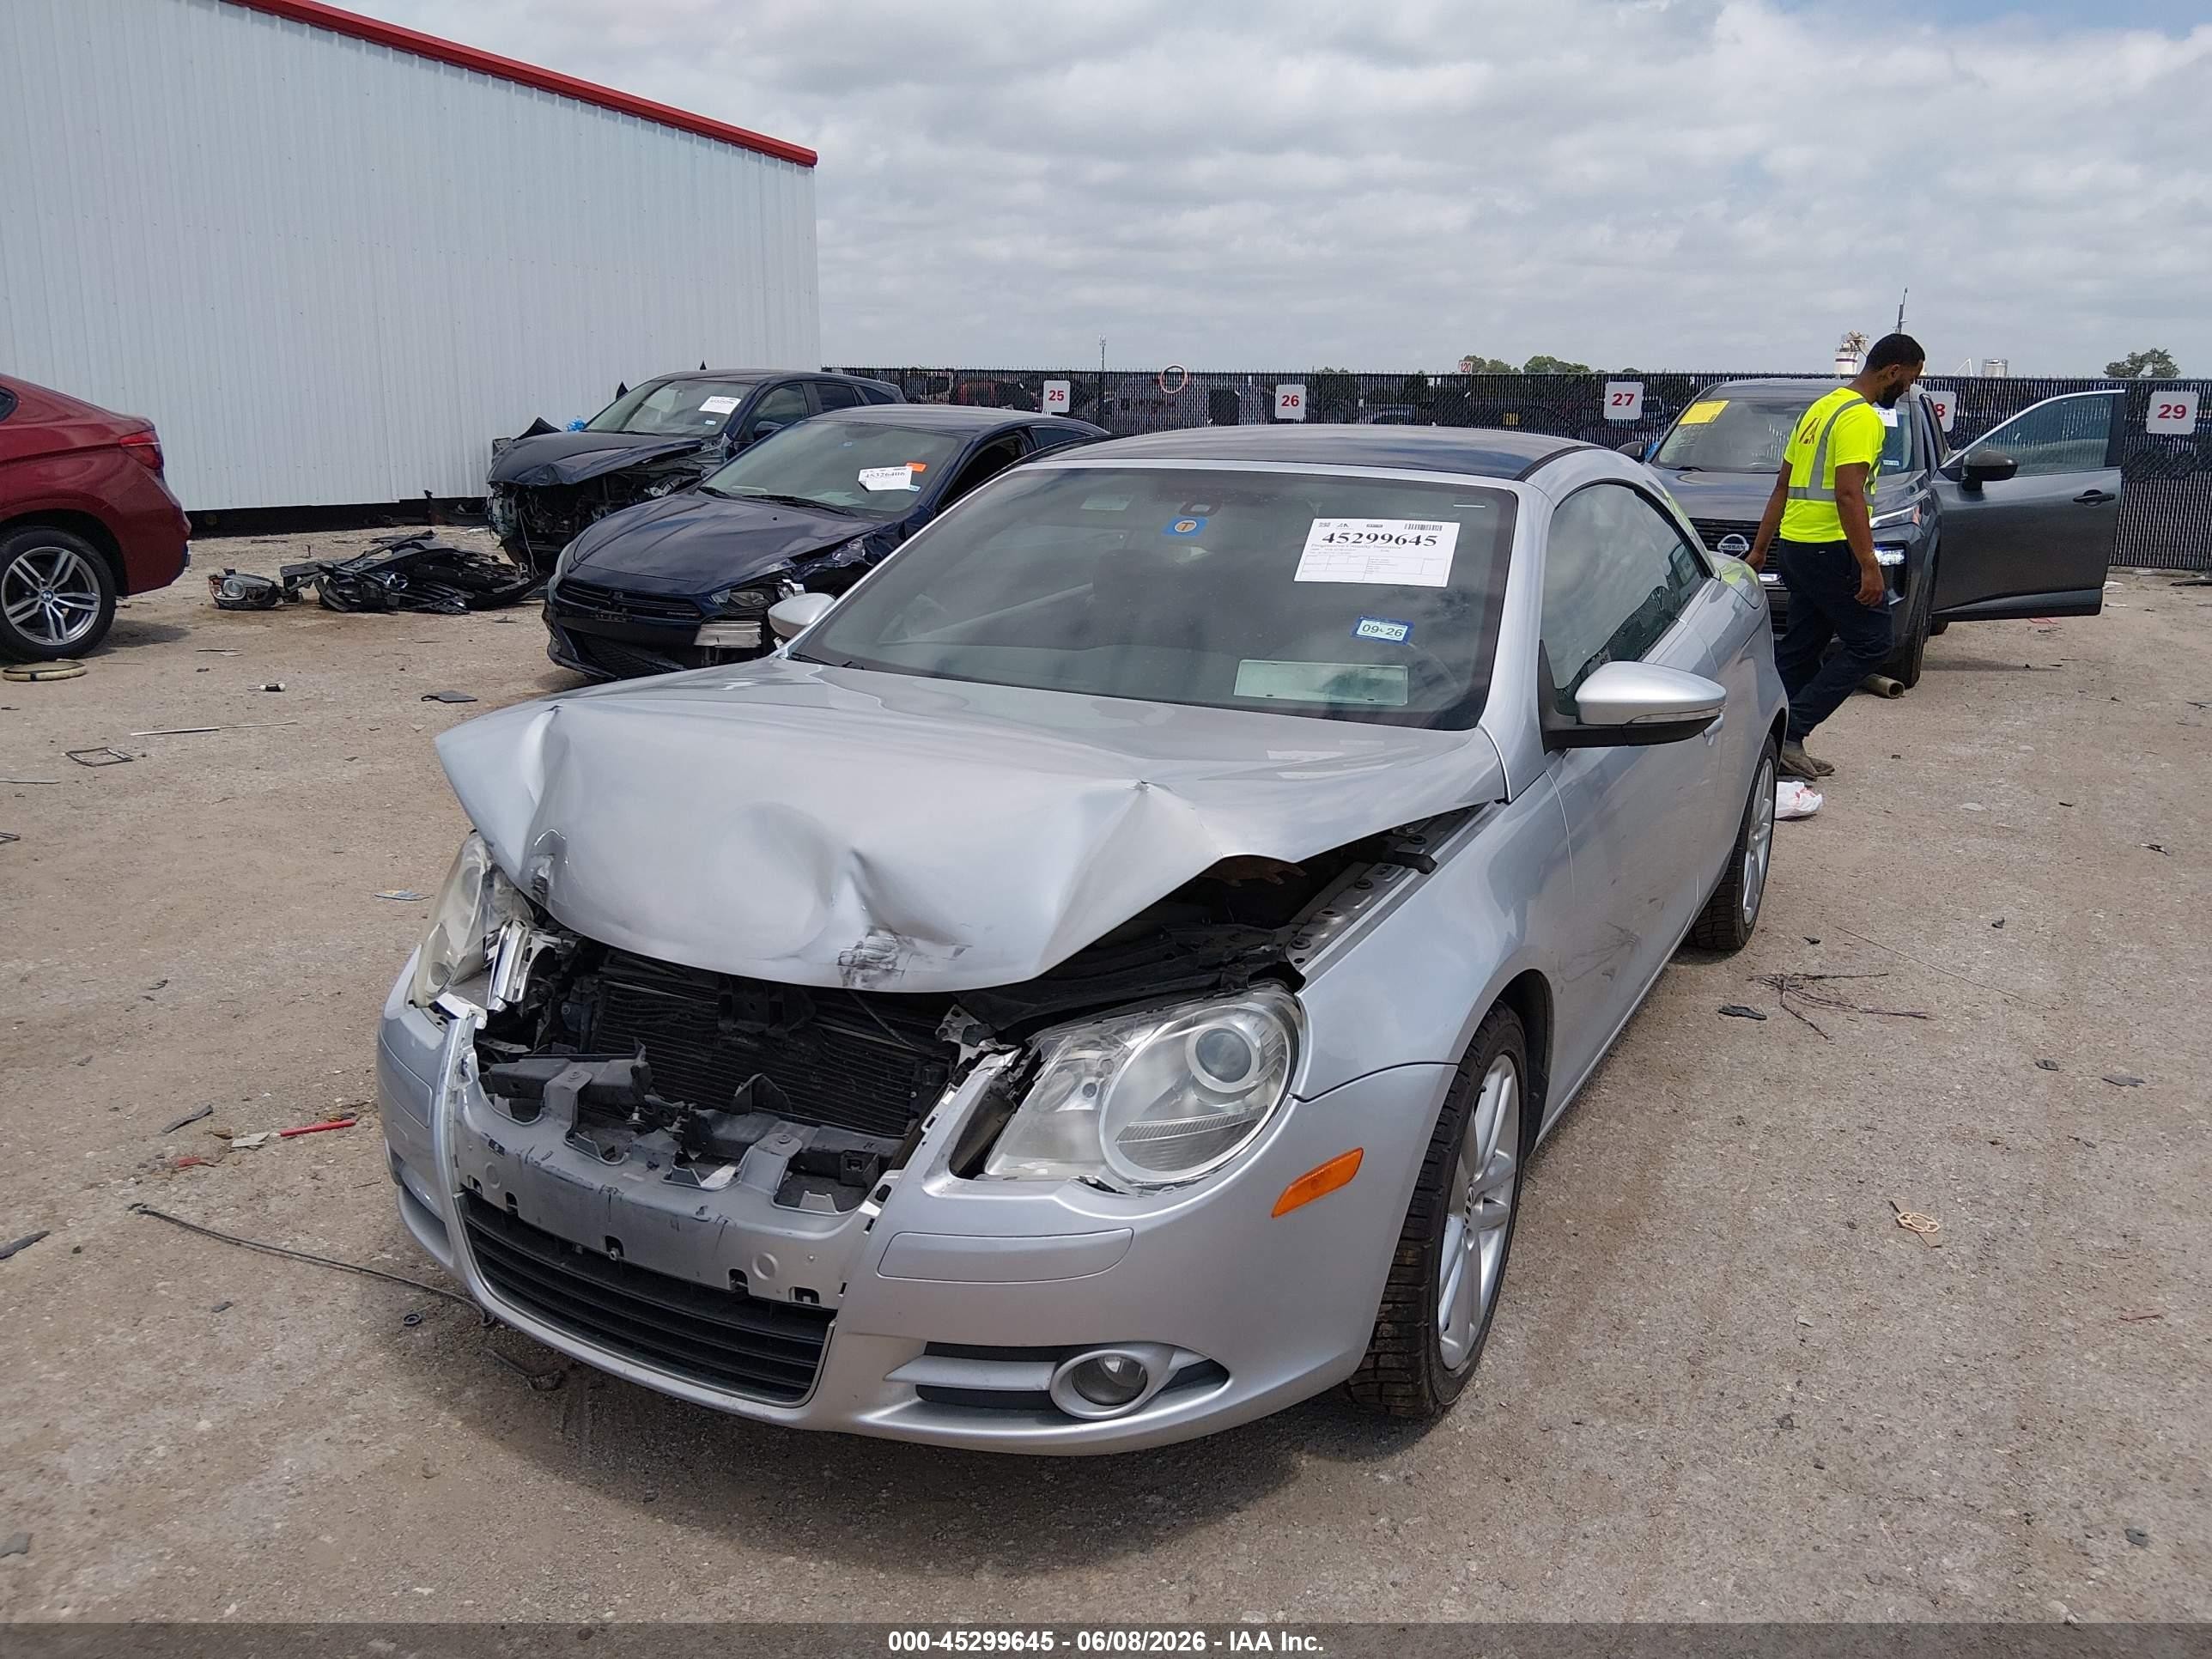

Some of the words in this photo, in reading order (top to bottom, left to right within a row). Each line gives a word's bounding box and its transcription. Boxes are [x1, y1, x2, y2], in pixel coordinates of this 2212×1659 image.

[1048, 390, 1065, 401] 25
[1281, 395, 1299, 407] 26
[1612, 392, 1635, 406] 27
[2157, 404, 2186, 419] 29
[1322, 532, 1439, 547] 45299645
